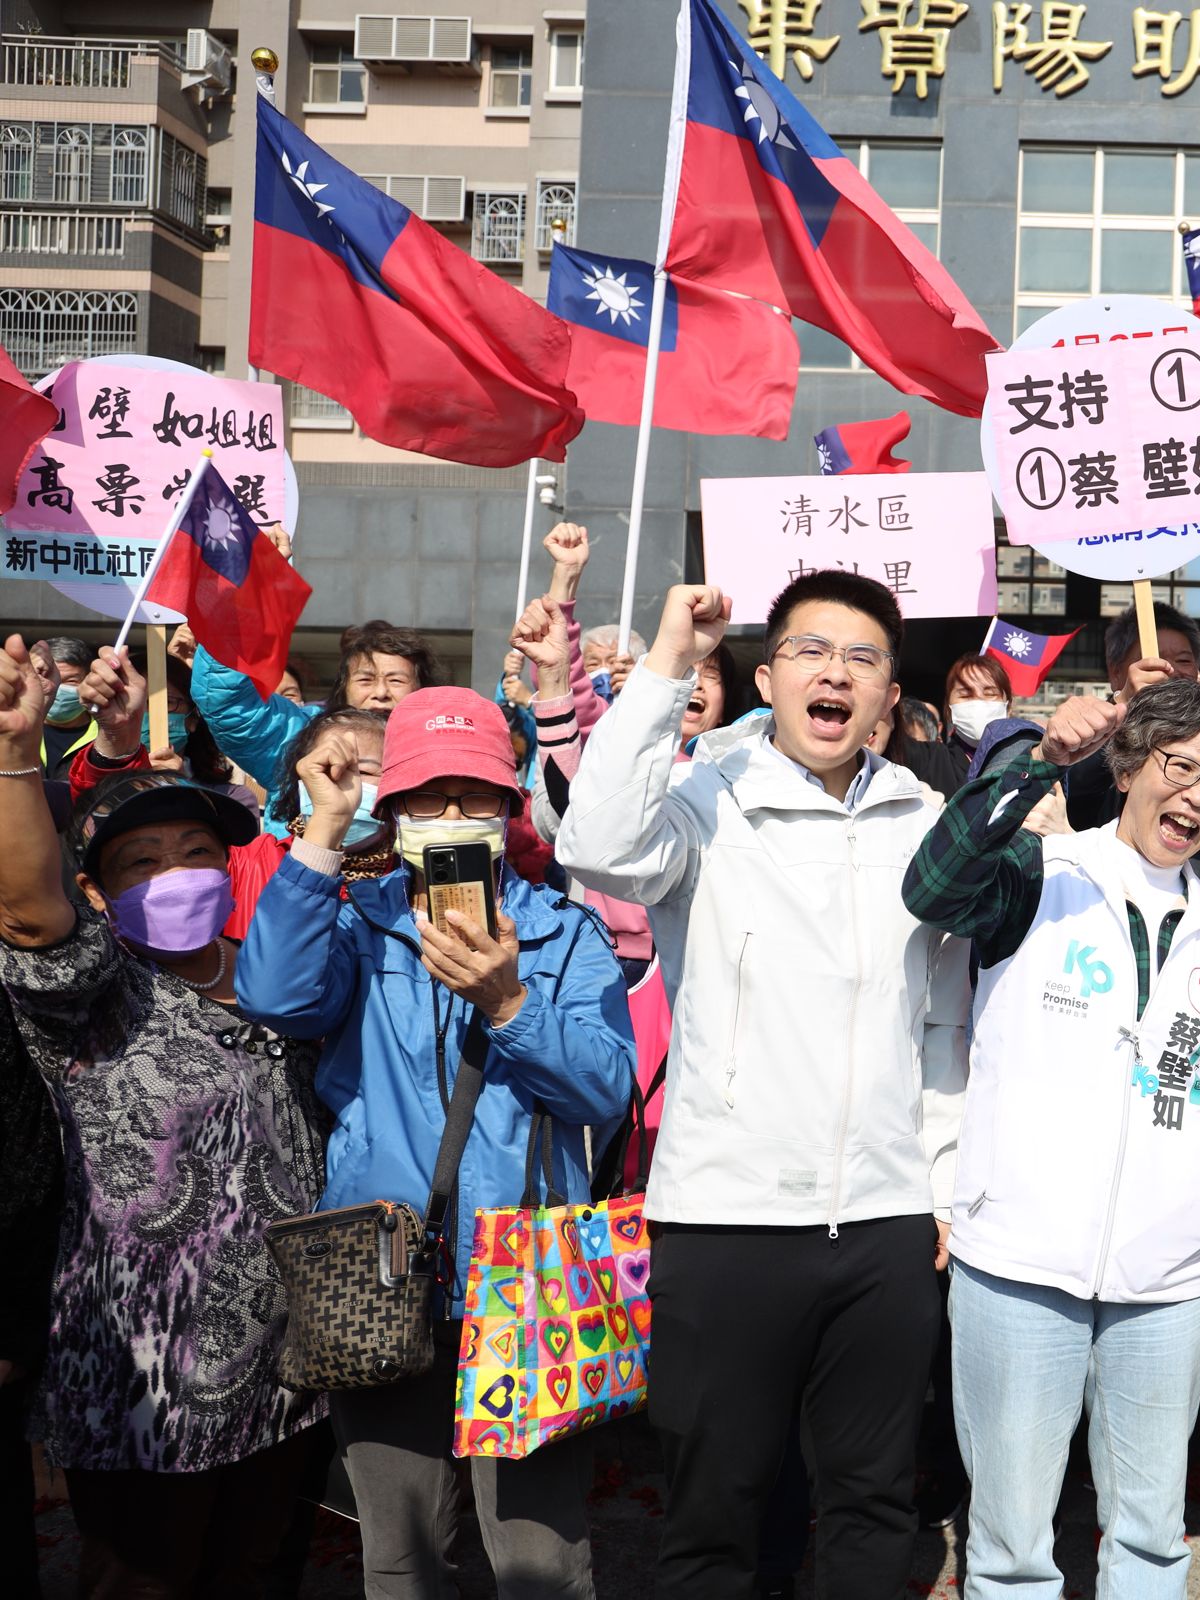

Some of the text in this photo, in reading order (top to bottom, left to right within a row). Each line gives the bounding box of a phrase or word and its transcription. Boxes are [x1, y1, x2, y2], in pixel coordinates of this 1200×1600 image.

[1004, 369, 1109, 435] 支持
[780, 494, 913, 537] 清水區
[1043, 992, 1089, 1010] Promise
[1045, 980, 1071, 995] Keep
